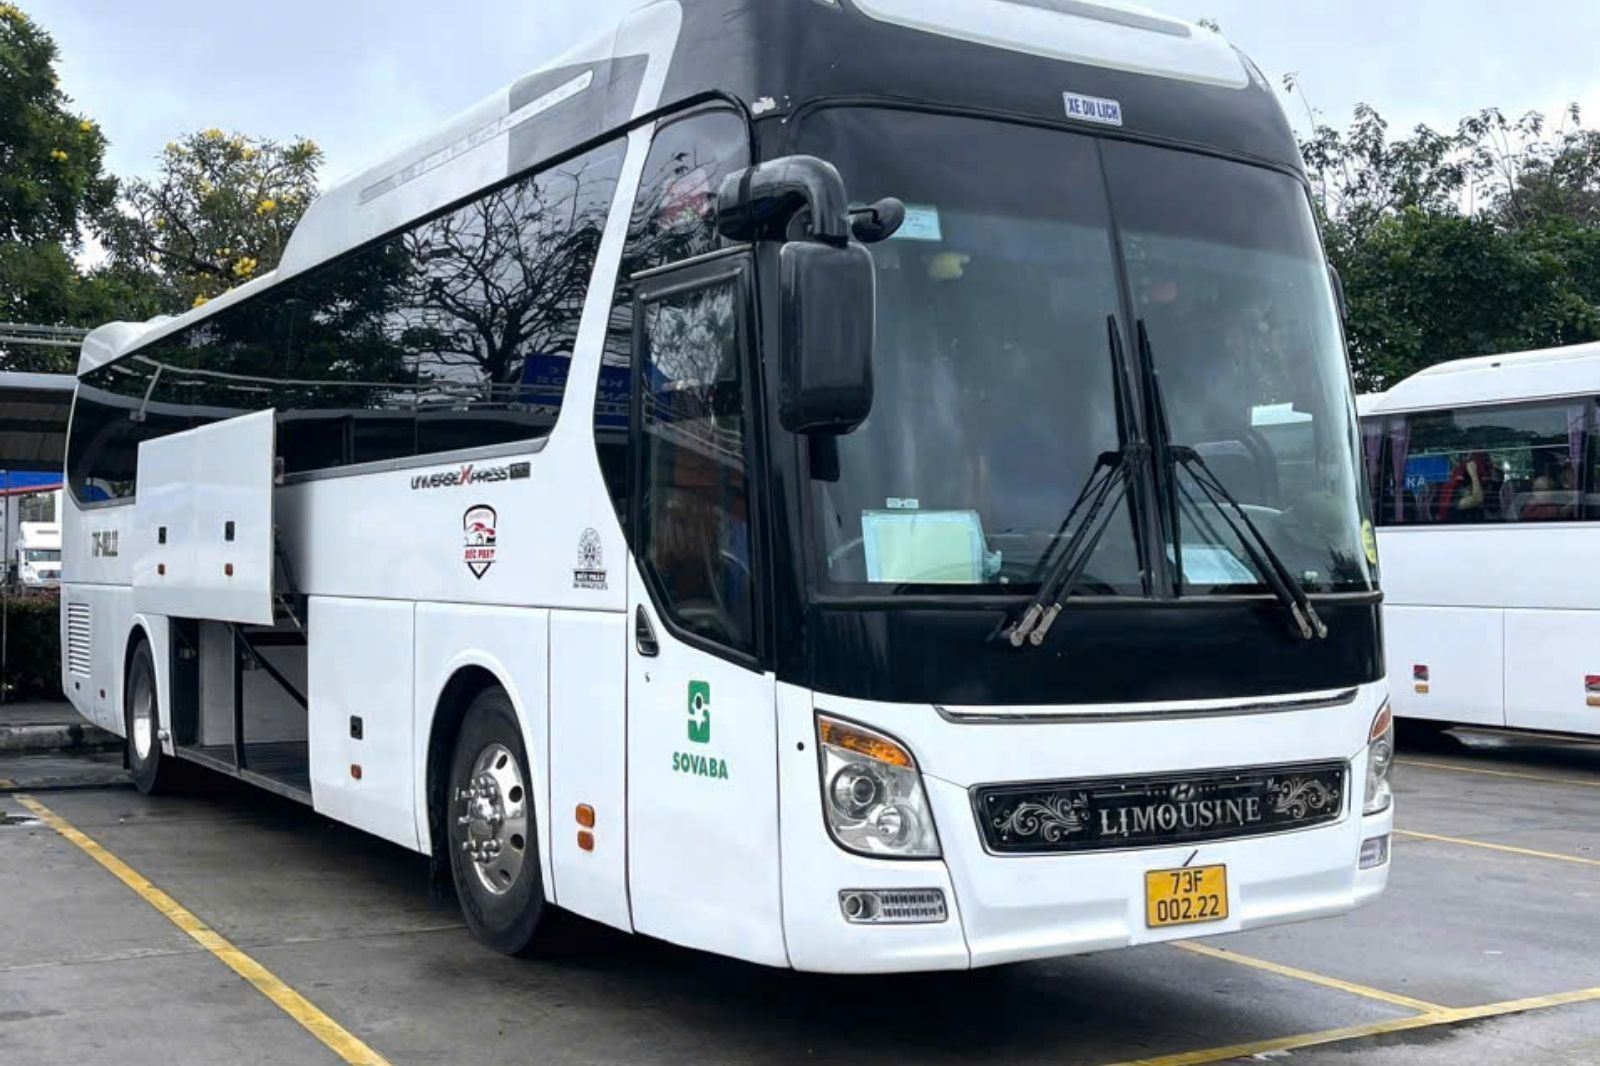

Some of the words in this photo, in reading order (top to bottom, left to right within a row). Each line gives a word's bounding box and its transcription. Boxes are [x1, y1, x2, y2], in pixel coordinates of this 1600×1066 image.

[1067, 97, 1081, 114] XE
[672, 751, 728, 780] SOVABA
[1099, 797, 1260, 836] LIMOUSINE
[1169, 870, 1204, 895] 73F
[1157, 895, 1220, 922] 002.22
